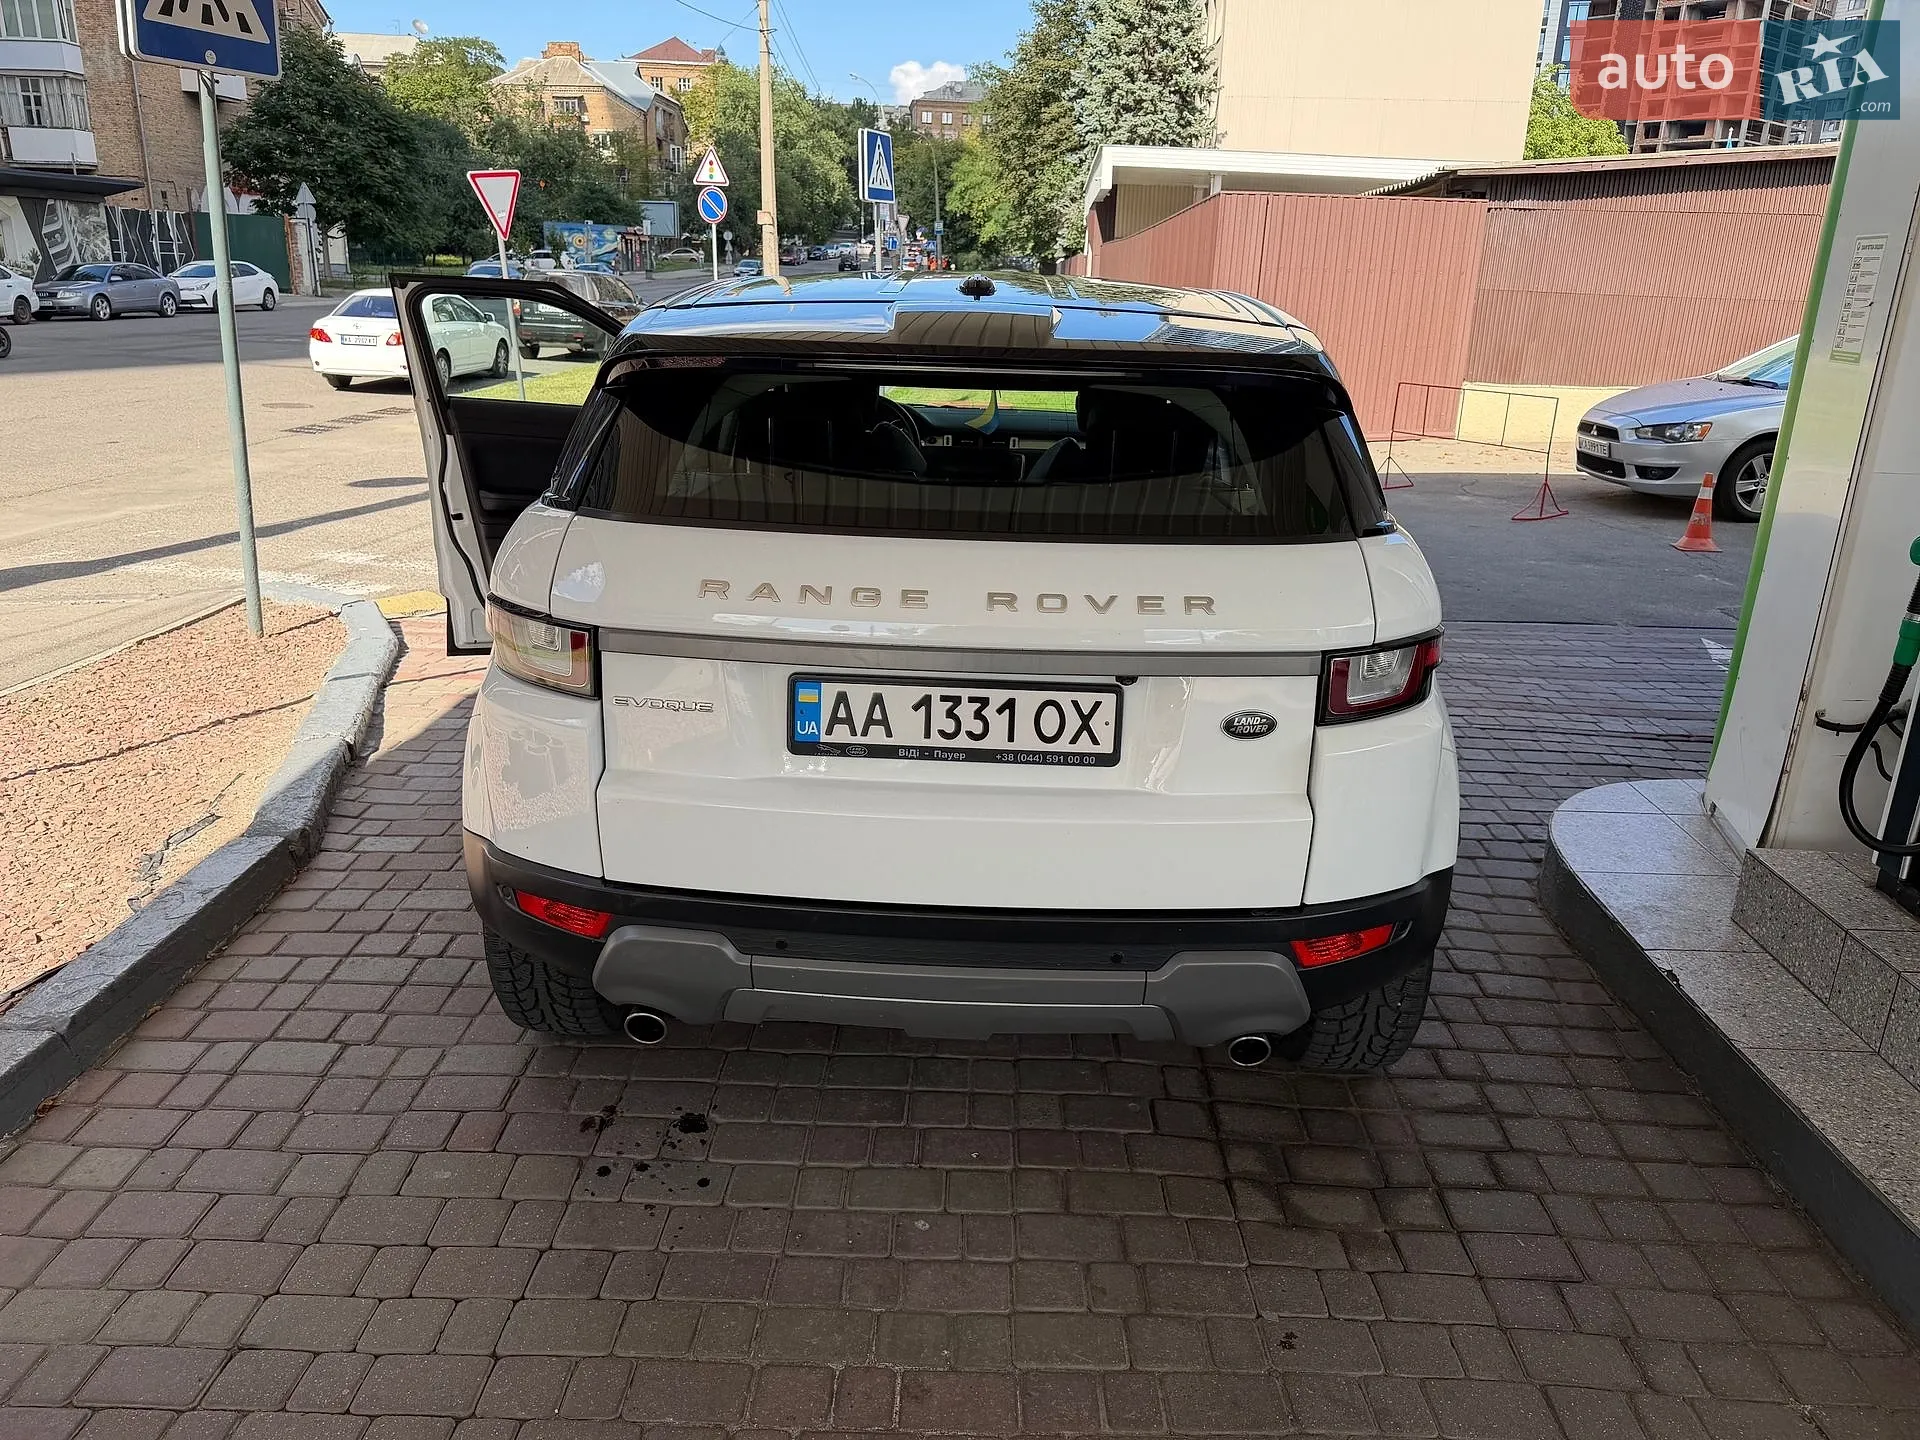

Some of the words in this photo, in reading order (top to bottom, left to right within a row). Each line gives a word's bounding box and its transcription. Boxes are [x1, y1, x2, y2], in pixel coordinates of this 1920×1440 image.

[697, 578, 929, 609] RANGE
[986, 591, 1217, 616] ROVER
[612, 695, 714, 713] EVOQUE
[825, 690, 893, 738] AA
[911, 693, 1016, 743] 1331
[1033, 699, 1103, 746] OX
[1233, 716, 1261, 726] LAND
[796, 720, 819, 736] UA
[1235, 724, 1268, 734] ROVER
[934, 749, 966, 761] Пауер
[995, 753, 1014, 761] +38
[1017, 753, 1043, 763] (044)
[1046, 754, 1064, 764] 591
[1067, 755, 1080, 764] 00
[1083, 755, 1095, 764] 00
